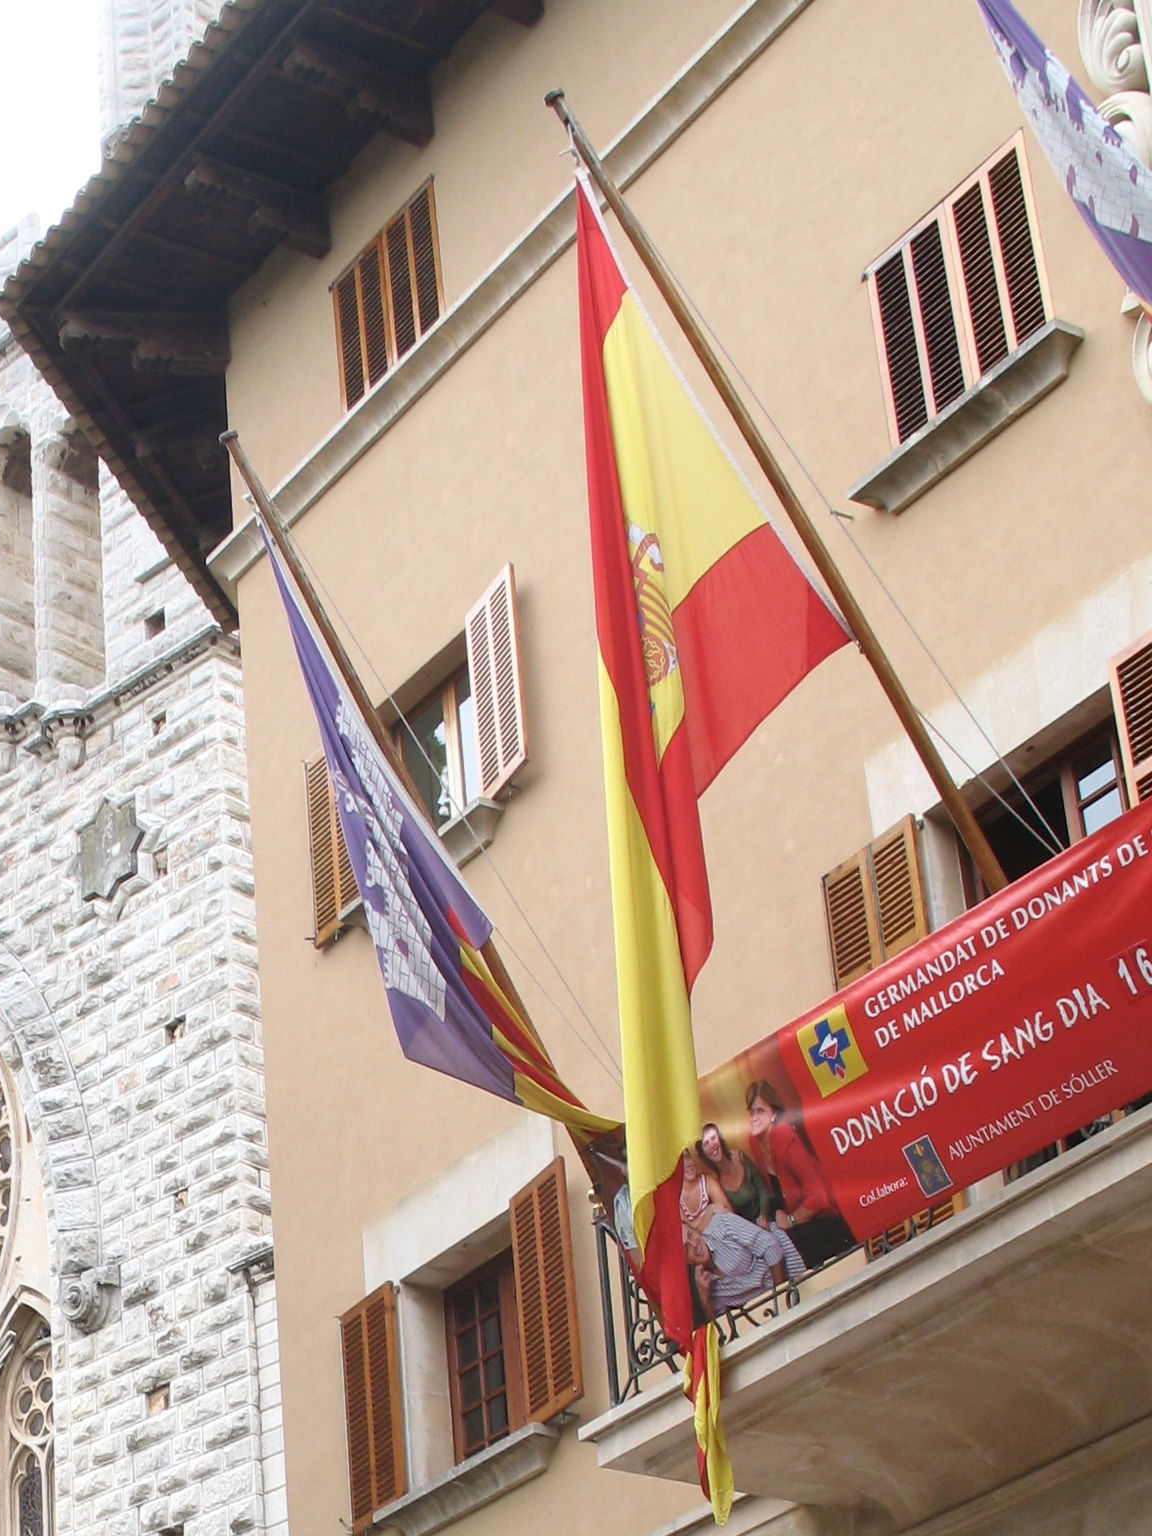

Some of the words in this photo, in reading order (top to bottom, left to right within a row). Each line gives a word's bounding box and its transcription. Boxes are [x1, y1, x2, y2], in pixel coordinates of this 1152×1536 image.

[863, 935, 979, 1018] GERMANDAT
[980, 918, 1010, 948] DE
[1011, 854, 1114, 931] DONANTS
[1116, 834, 1149, 868] DE
[830, 1065, 939, 1155] DONACIÓ
[941, 1052, 979, 1094] DE
[980, 1010, 1055, 1071] SANG
[1055, 983, 1111, 1029] DIA
[873, 1019, 901, 1049] DE
[902, 958, 1006, 1033] MALLORCA
[949, 1101, 1038, 1161] AJUNTAMENT
[1038, 1088, 1063, 1112] DE
[1061, 1058, 1119, 1100] SÓLLER
